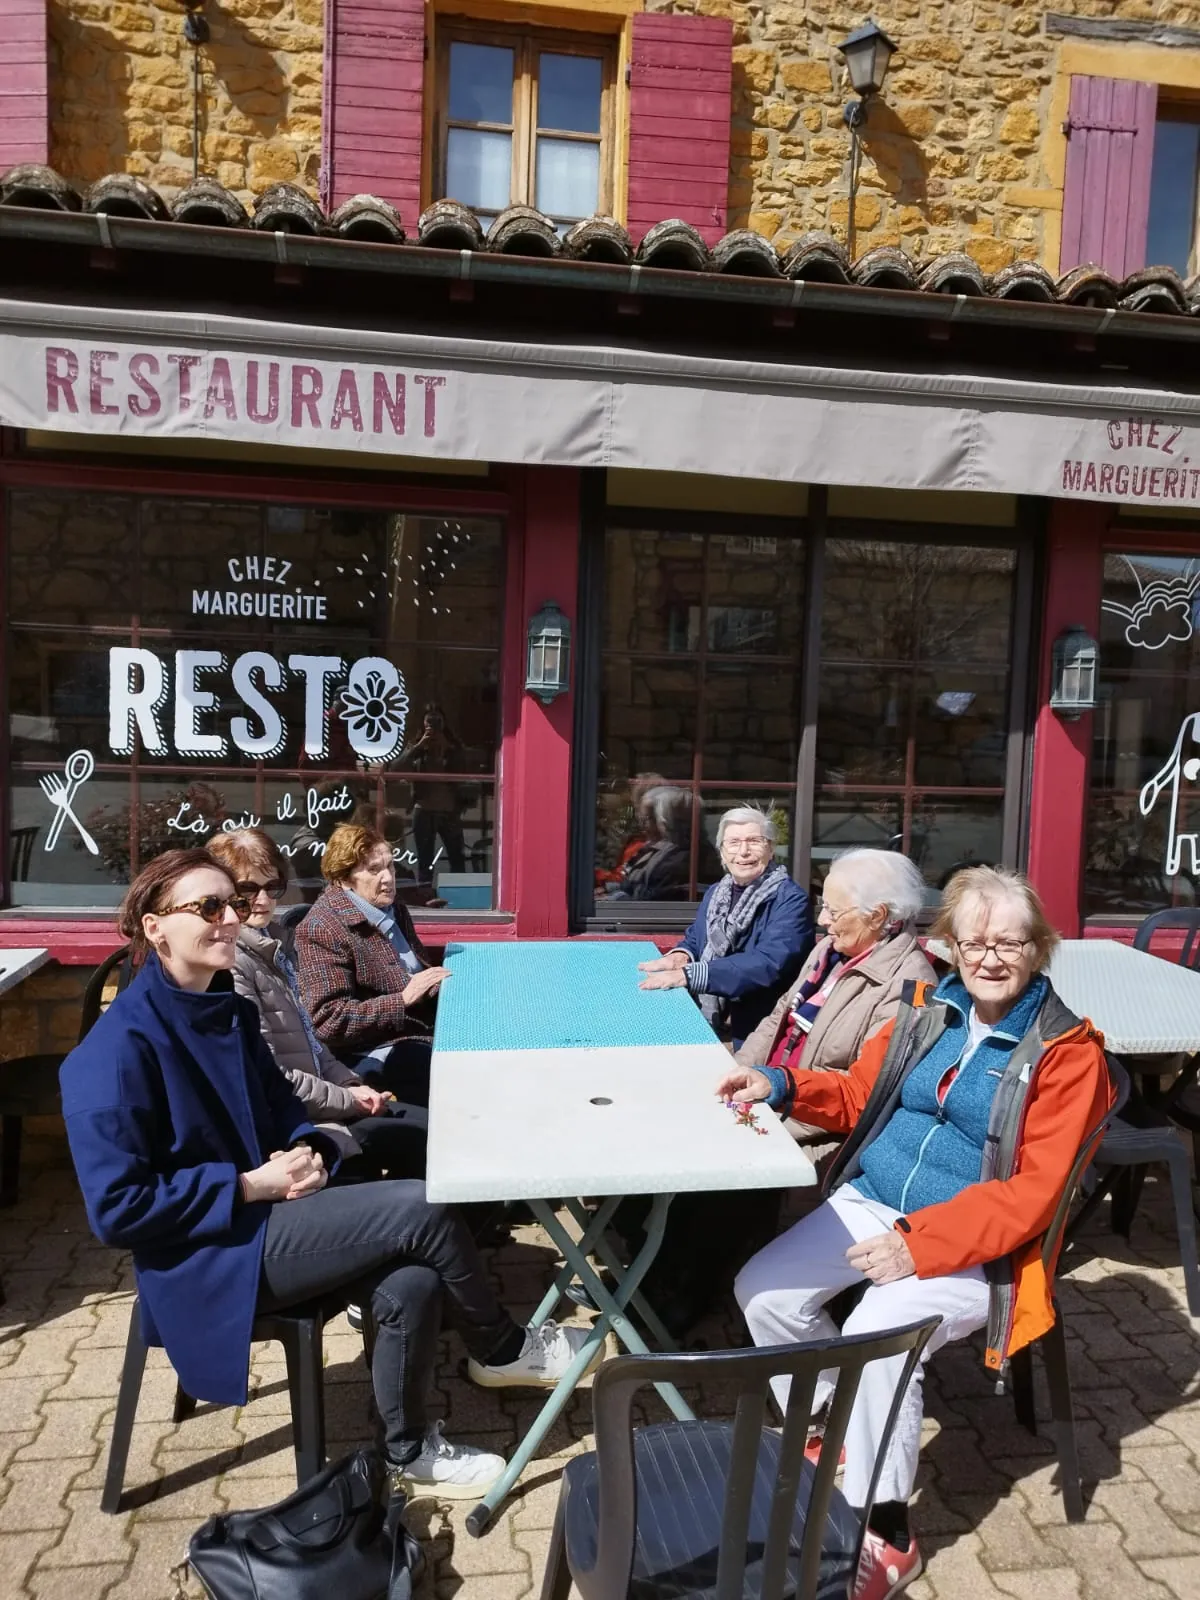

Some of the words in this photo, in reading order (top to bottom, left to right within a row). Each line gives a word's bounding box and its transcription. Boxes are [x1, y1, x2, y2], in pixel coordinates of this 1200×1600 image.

[45, 345, 447, 438] RESTAURANT
[1106, 416, 1183, 455] CHEZ
[1061, 457, 1200, 499] MARGUERIT
[227, 555, 293, 585] CHEZ
[108, 646, 410, 763] RESTO
[167, 802, 210, 833] Là
[222, 811, 261, 833] où
[276, 792, 297, 822] il
[307, 785, 352, 828] fait
